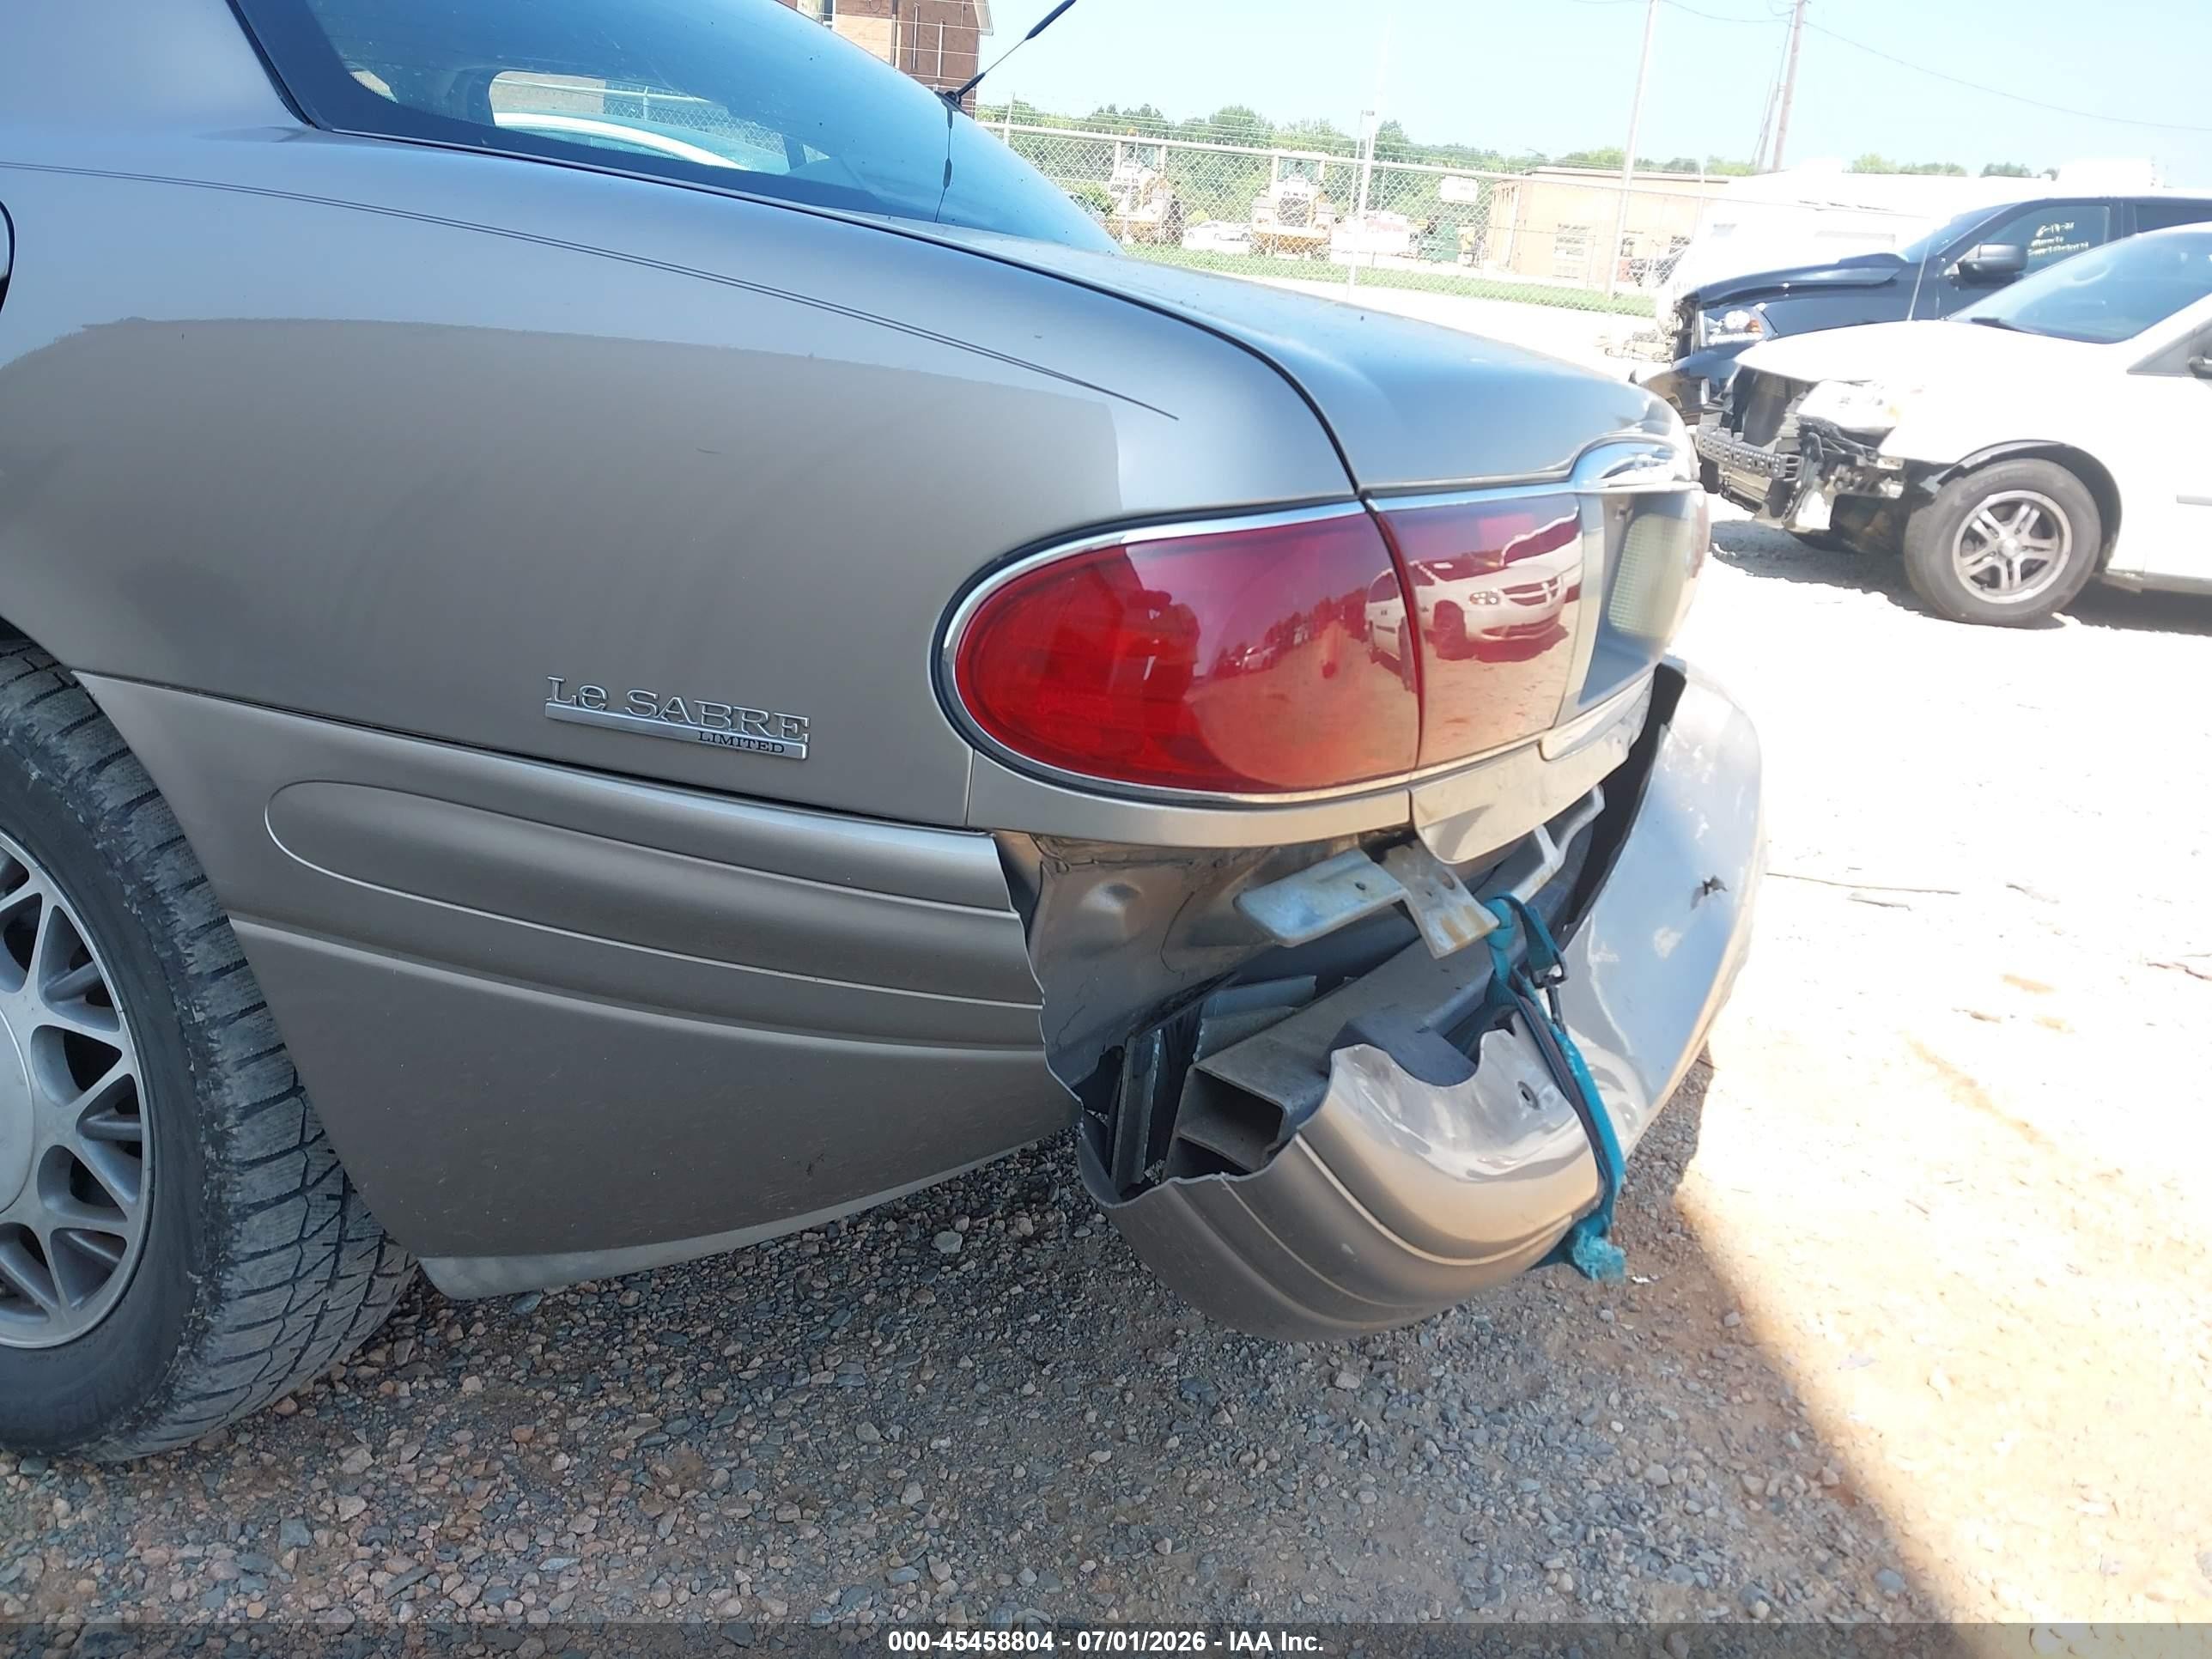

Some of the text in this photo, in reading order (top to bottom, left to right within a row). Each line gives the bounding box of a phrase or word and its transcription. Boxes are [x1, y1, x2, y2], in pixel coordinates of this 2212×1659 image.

[545, 676, 811, 743] Le SABRE
[697, 730, 786, 755] LIMITED
